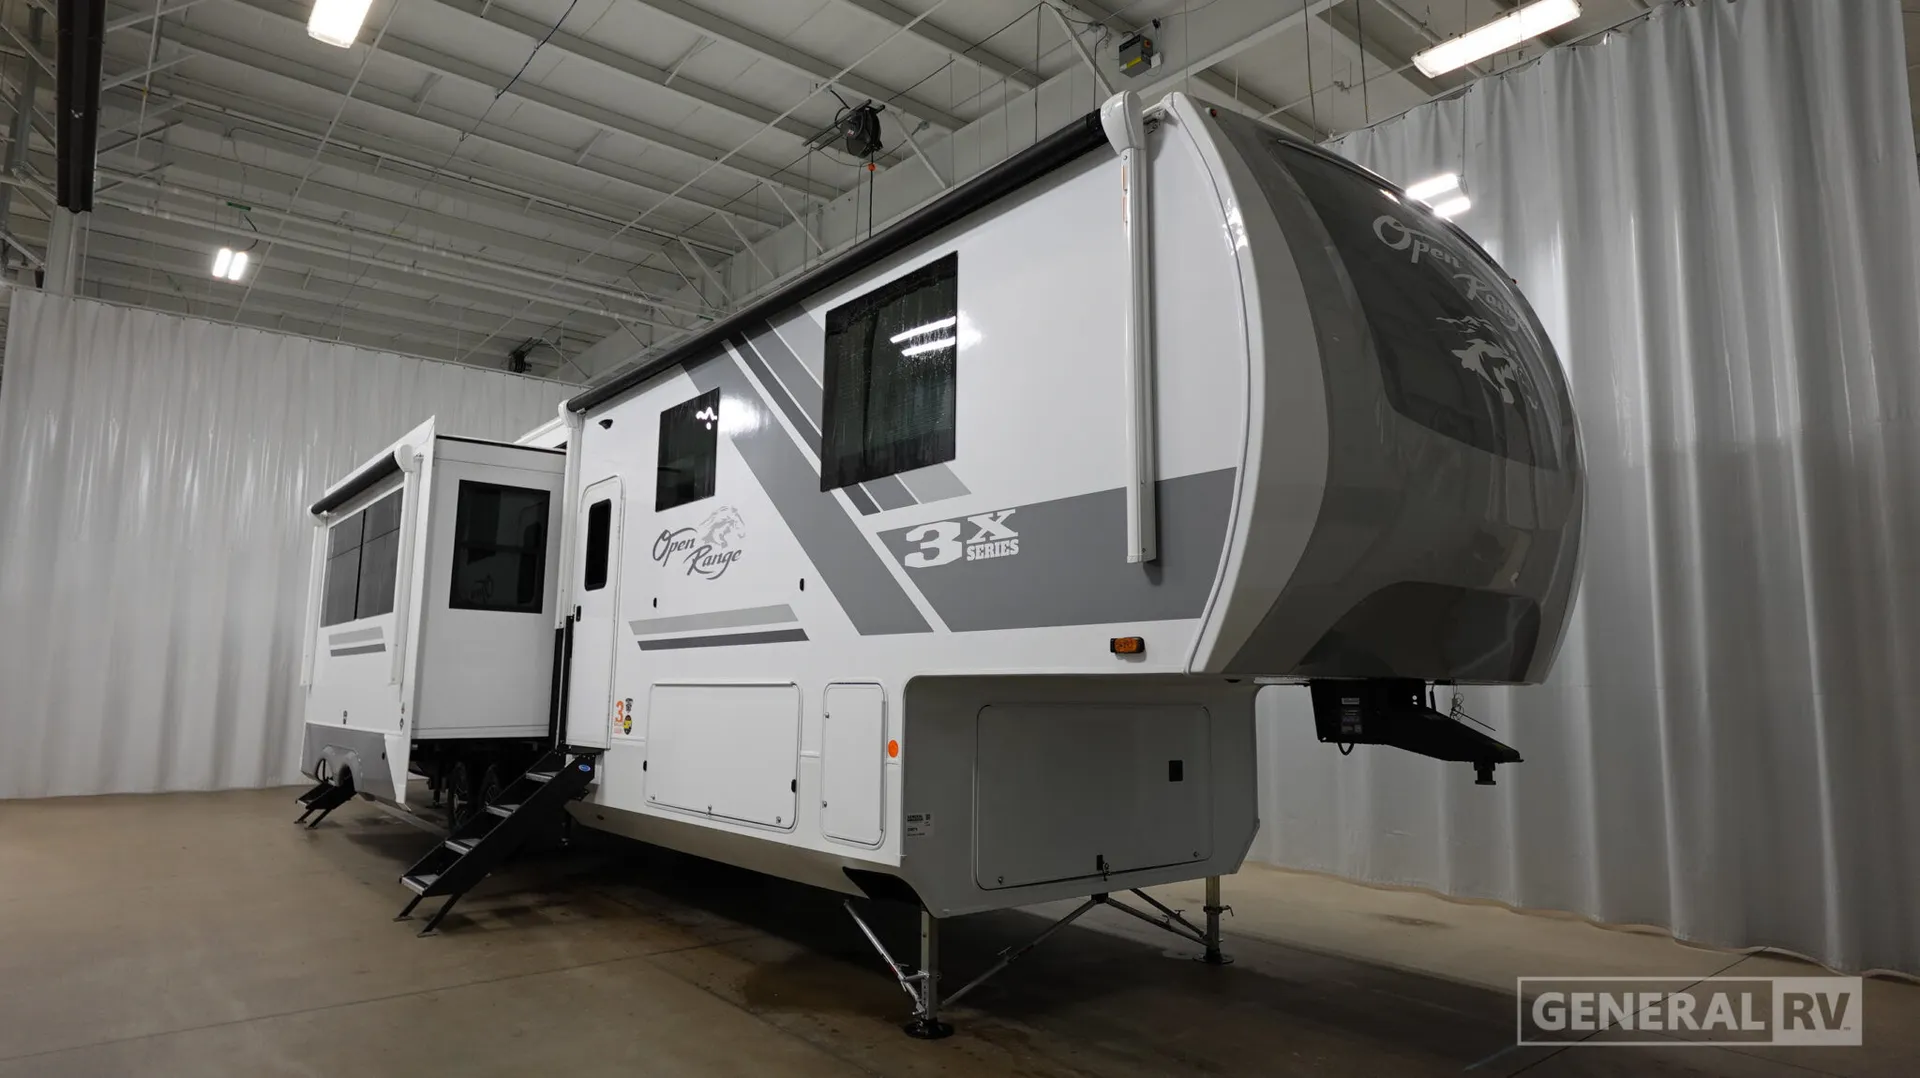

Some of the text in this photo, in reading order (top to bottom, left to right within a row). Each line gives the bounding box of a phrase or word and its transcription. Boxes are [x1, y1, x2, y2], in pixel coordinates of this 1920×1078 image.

[1372, 215, 1461, 269] Open
[1453, 273, 1520, 332] Rang
[652, 527, 698, 567] Open
[683, 544, 742, 580] Range
[966, 538, 1020, 561] SERIES
